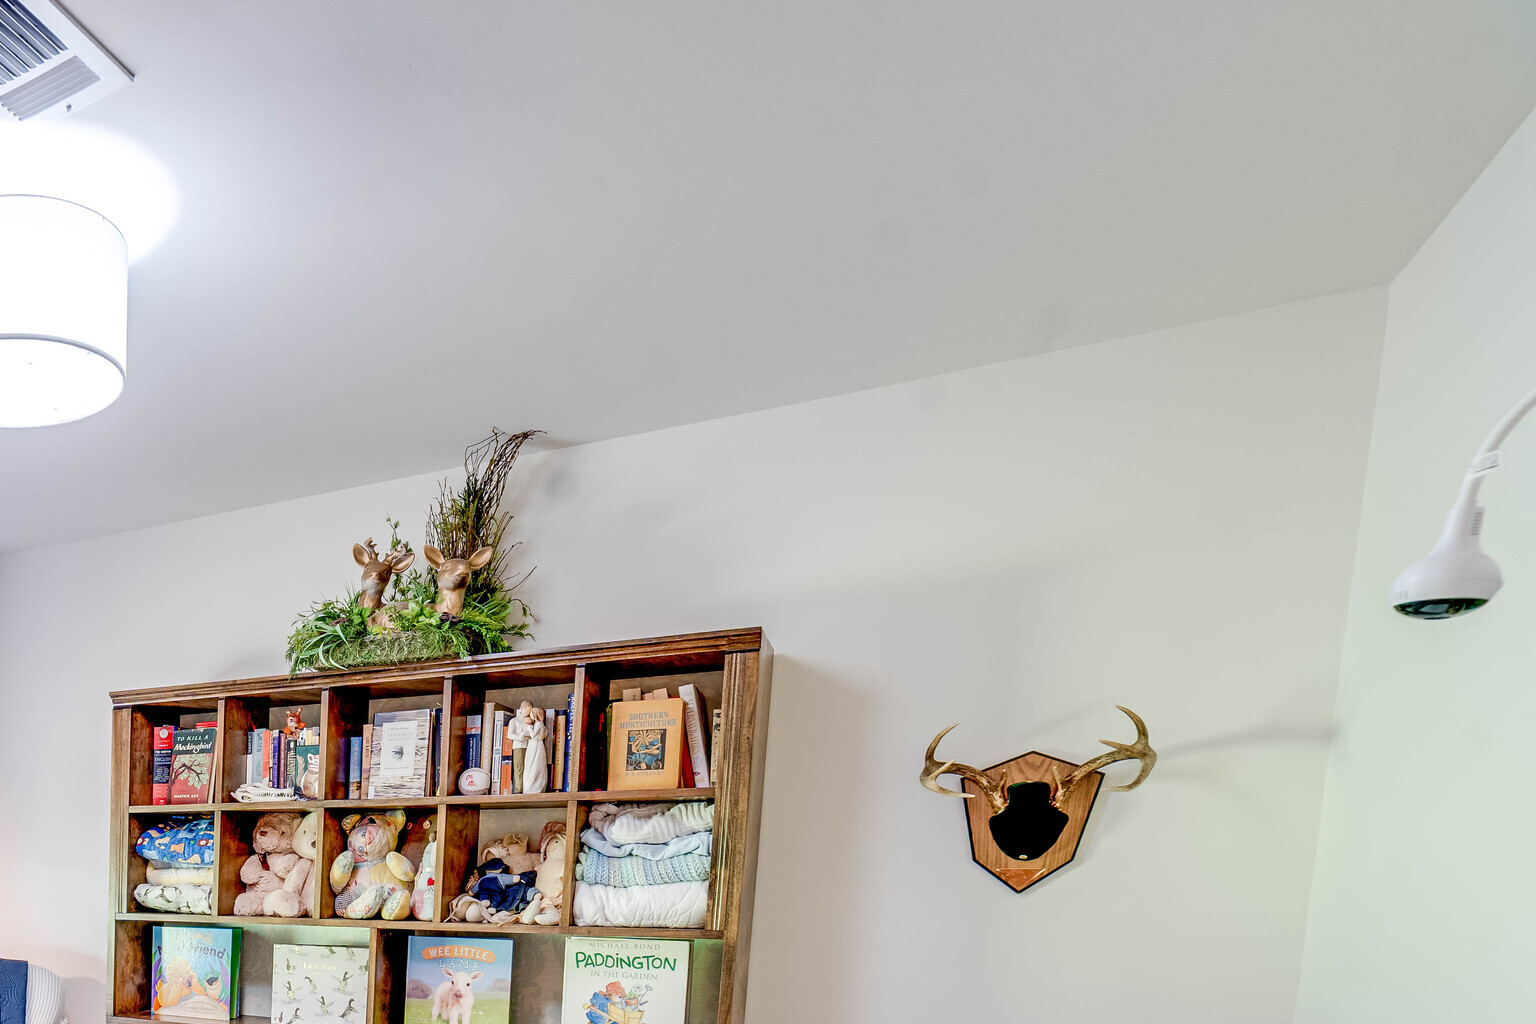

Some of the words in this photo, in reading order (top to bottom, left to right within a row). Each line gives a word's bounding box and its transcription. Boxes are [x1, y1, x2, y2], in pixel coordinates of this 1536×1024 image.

[628, 711, 669, 720] SOUTHERN
[620, 718, 677, 729] HORTICULTURE
[174, 741, 213, 754] Mockingbird
[589, 942, 629, 950] MICHAEL
[634, 943, 661, 951] BOND
[429, 946, 450, 958] WEE
[454, 946, 489, 961] LITTLE
[439, 960, 479, 971] LAMB
[575, 951, 677, 972] PADDINGTON
[604, 970, 619, 979] THE
[622, 971, 659, 981] GARDEN
